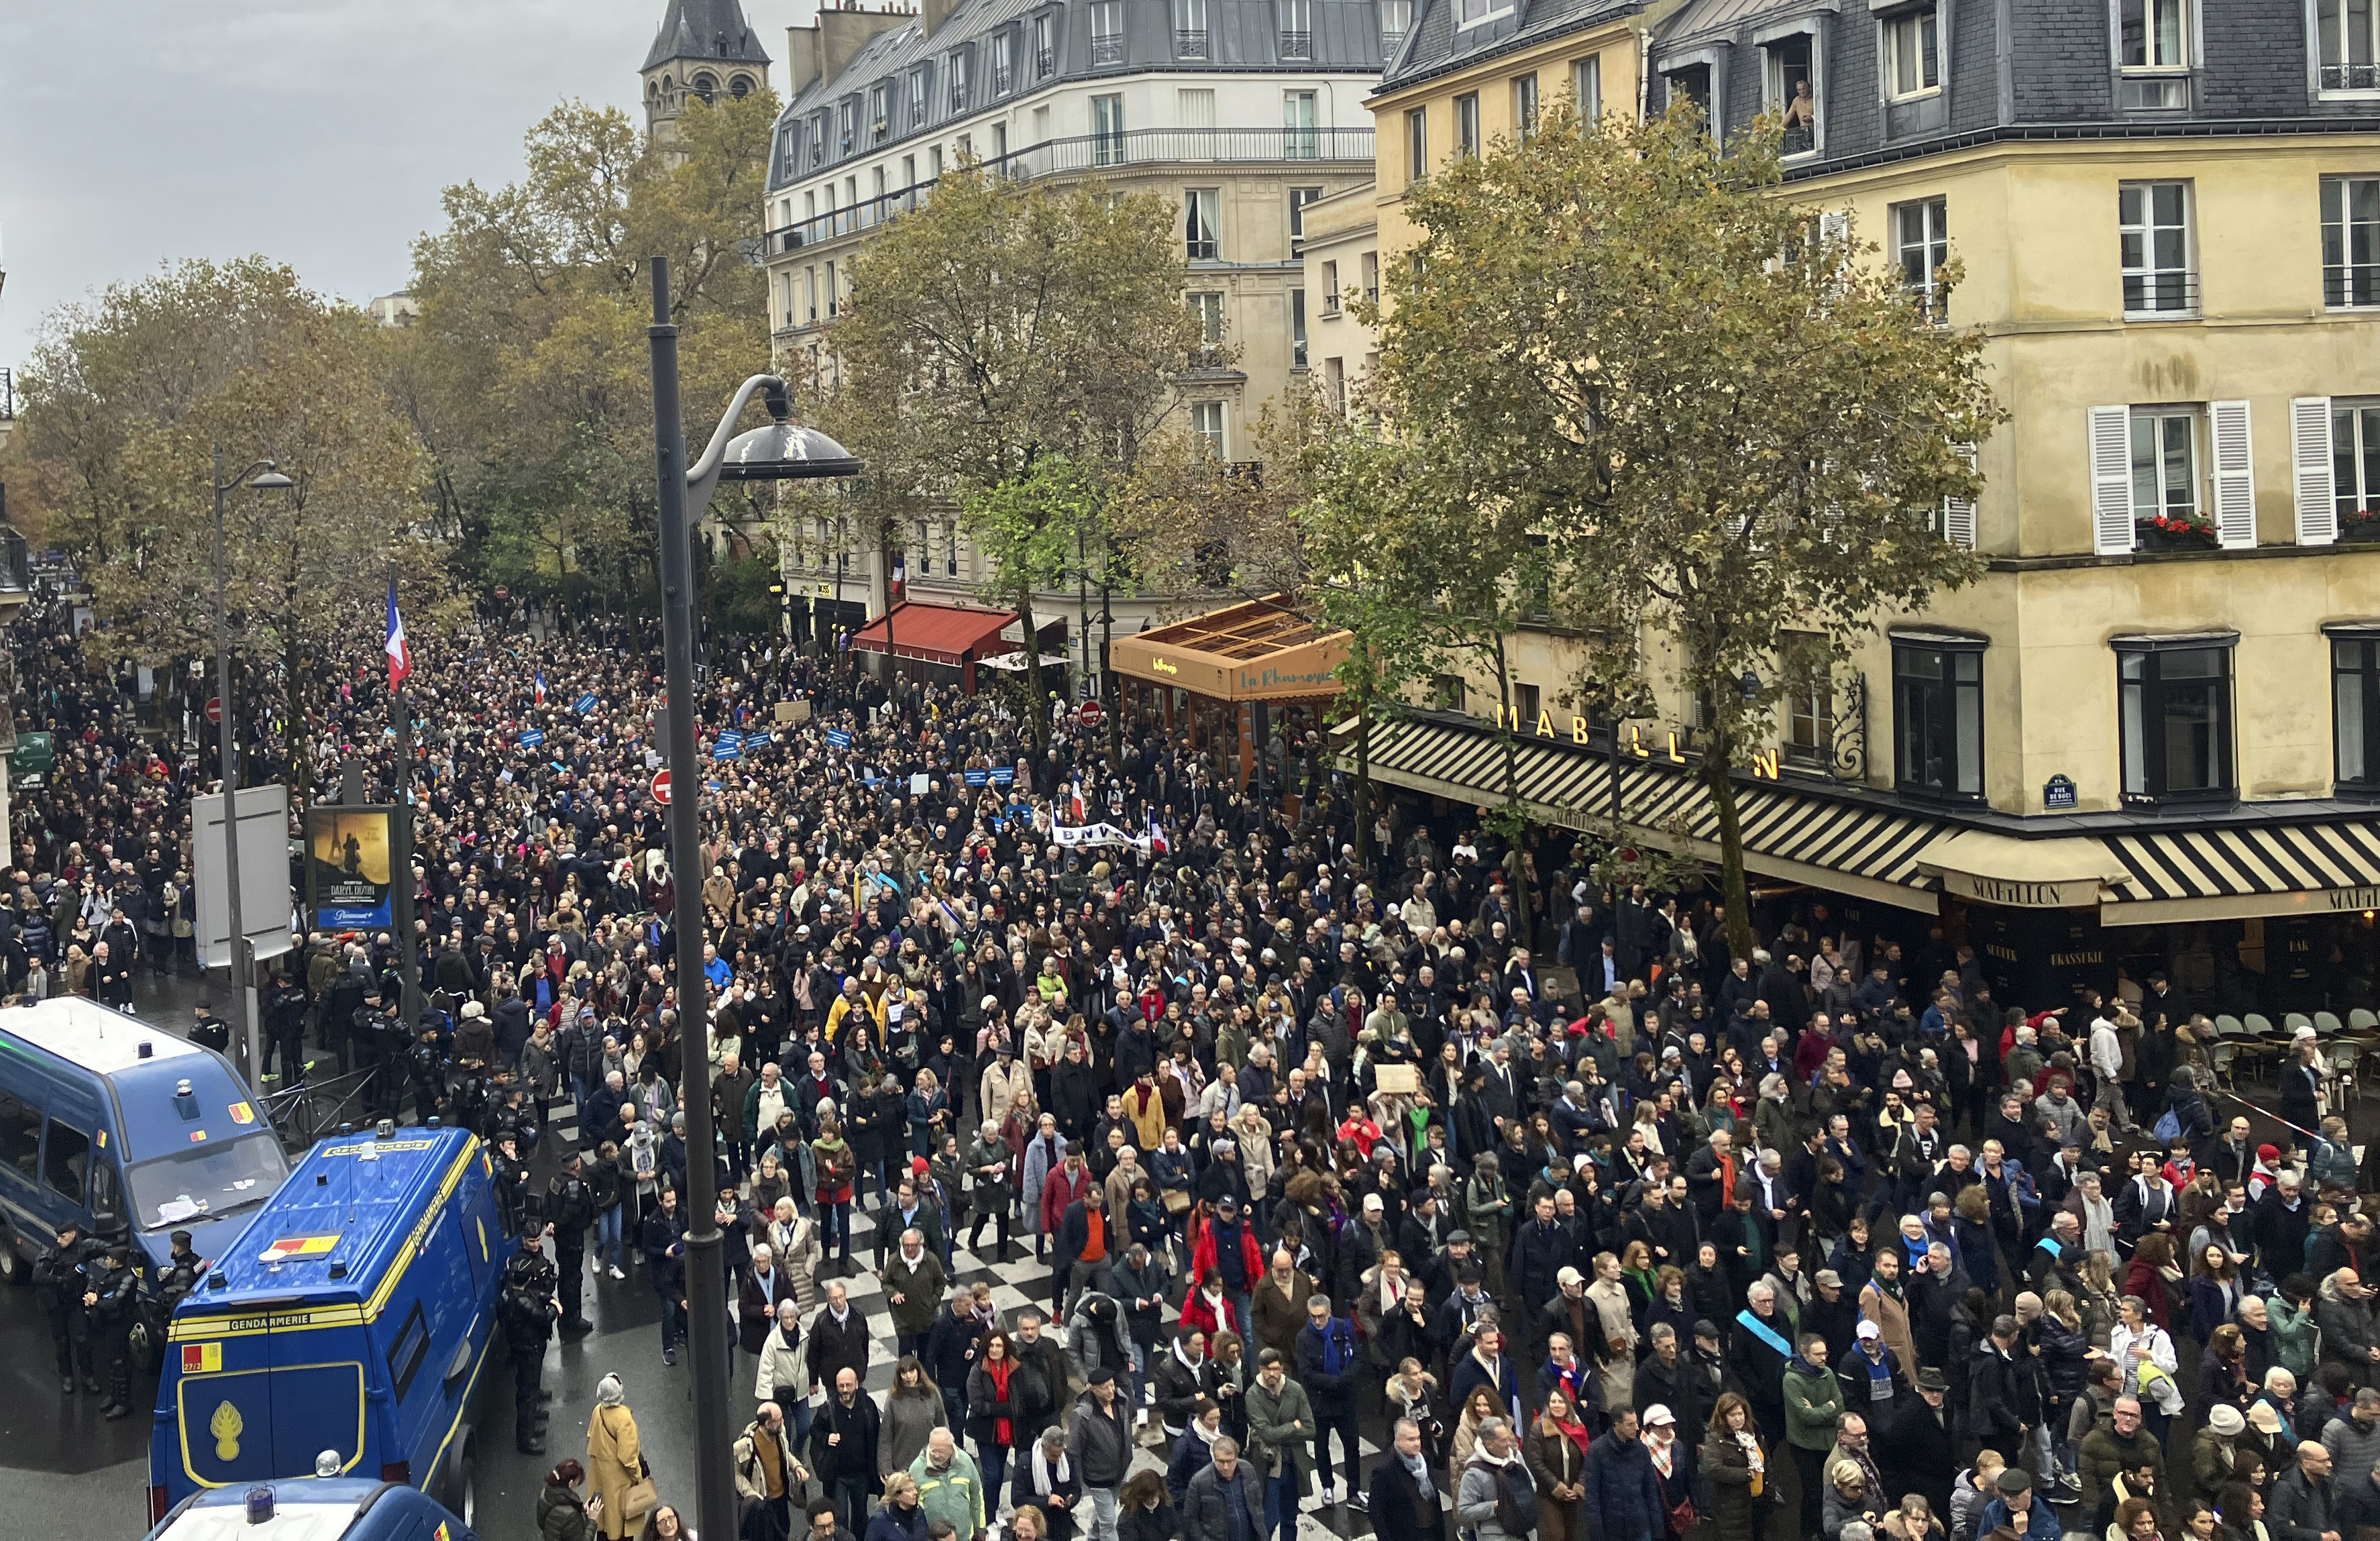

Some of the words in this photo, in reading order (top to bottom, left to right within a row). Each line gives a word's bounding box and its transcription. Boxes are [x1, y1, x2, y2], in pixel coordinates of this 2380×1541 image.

[1241, 671, 1259, 689] La
[1497, 702, 1778, 780] MABLLN
[331, 886, 354, 896] DARYL
[354, 886, 375, 896] DIXON
[2051, 951, 2104, 966] BRASSERIE
[332, 1143, 425, 1155] GENDRMERIE
[411, 1188, 445, 1247] GENDARMERIE
[231, 1314, 309, 1330] GENDARMERIE
[184, 1362, 201, 1371] 27/2
